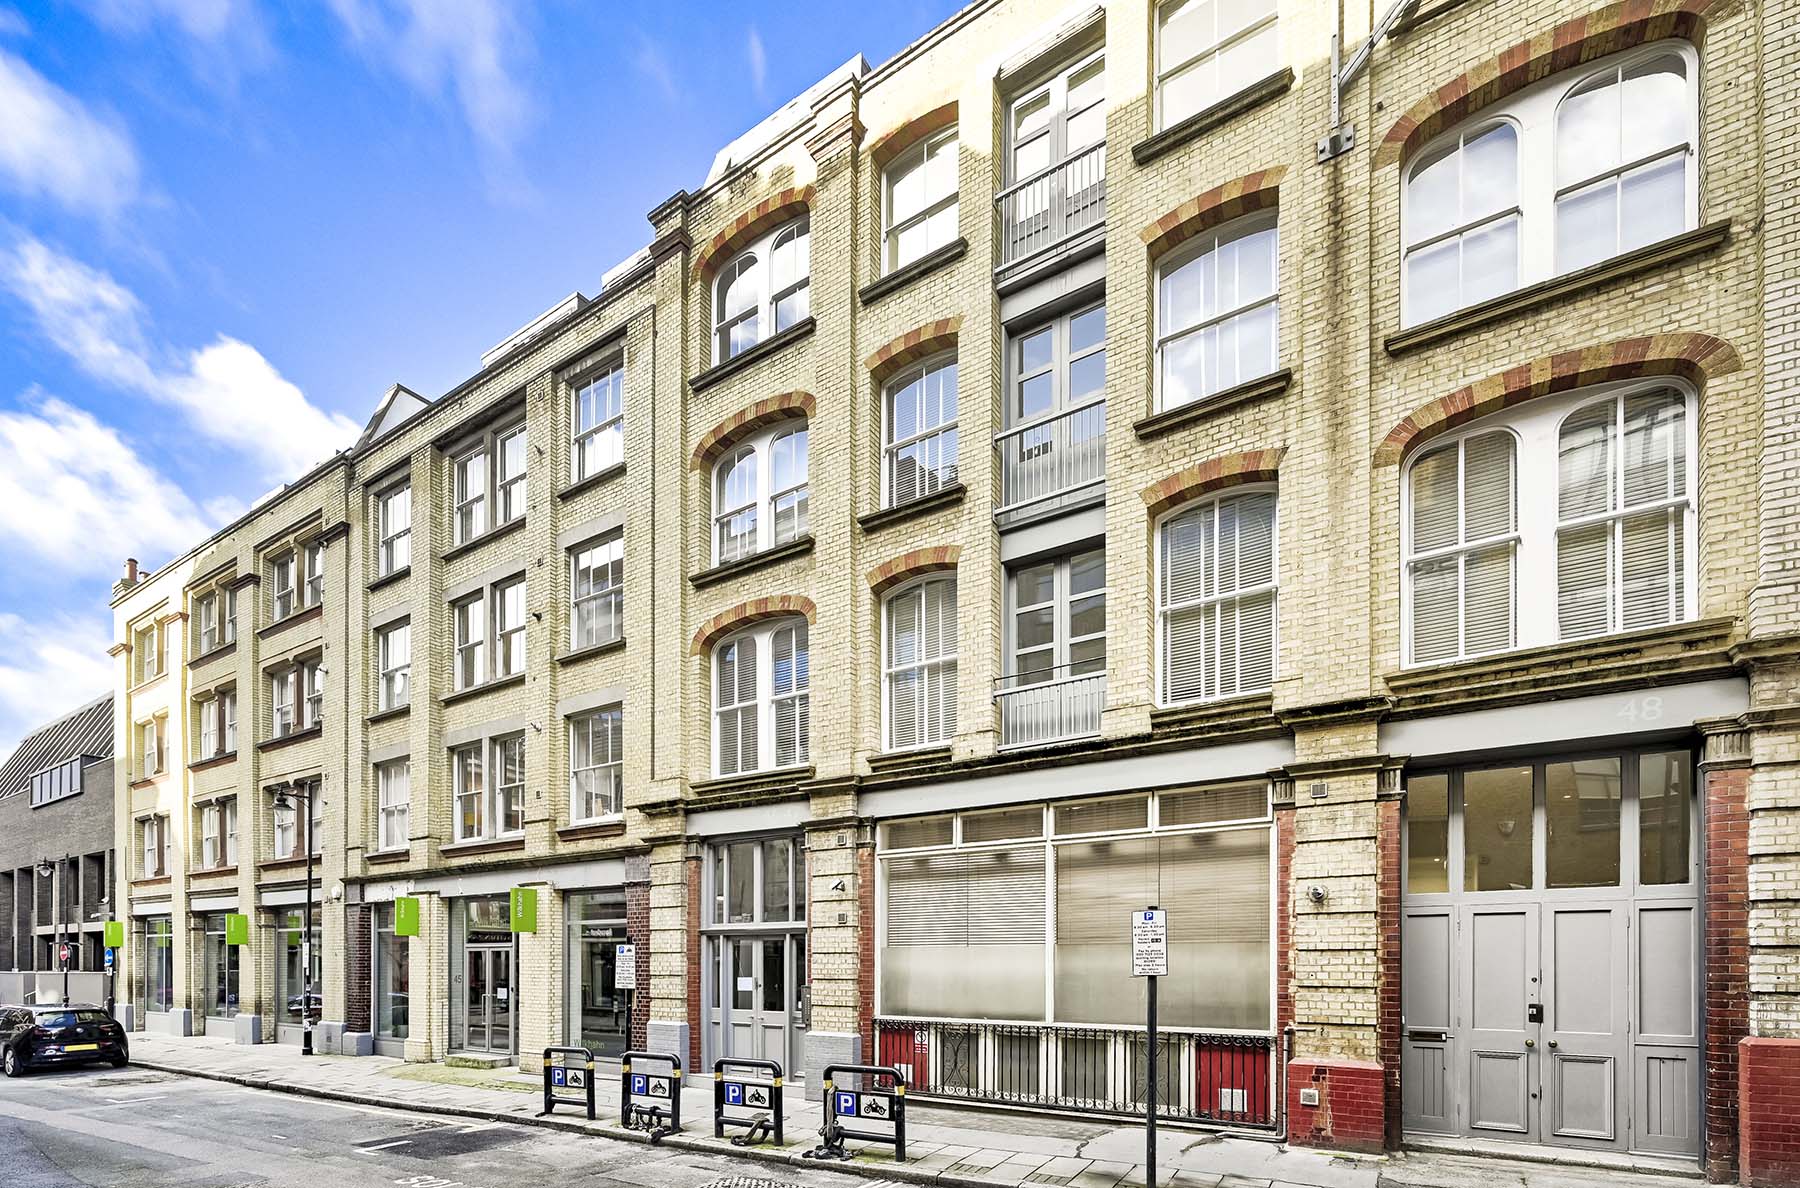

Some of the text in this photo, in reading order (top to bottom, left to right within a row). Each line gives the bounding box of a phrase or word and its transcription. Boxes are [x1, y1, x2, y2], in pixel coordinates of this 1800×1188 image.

[1616, 696, 1664, 721] 48
[729, 1085, 739, 1102] P
[840, 1095, 853, 1112] P
